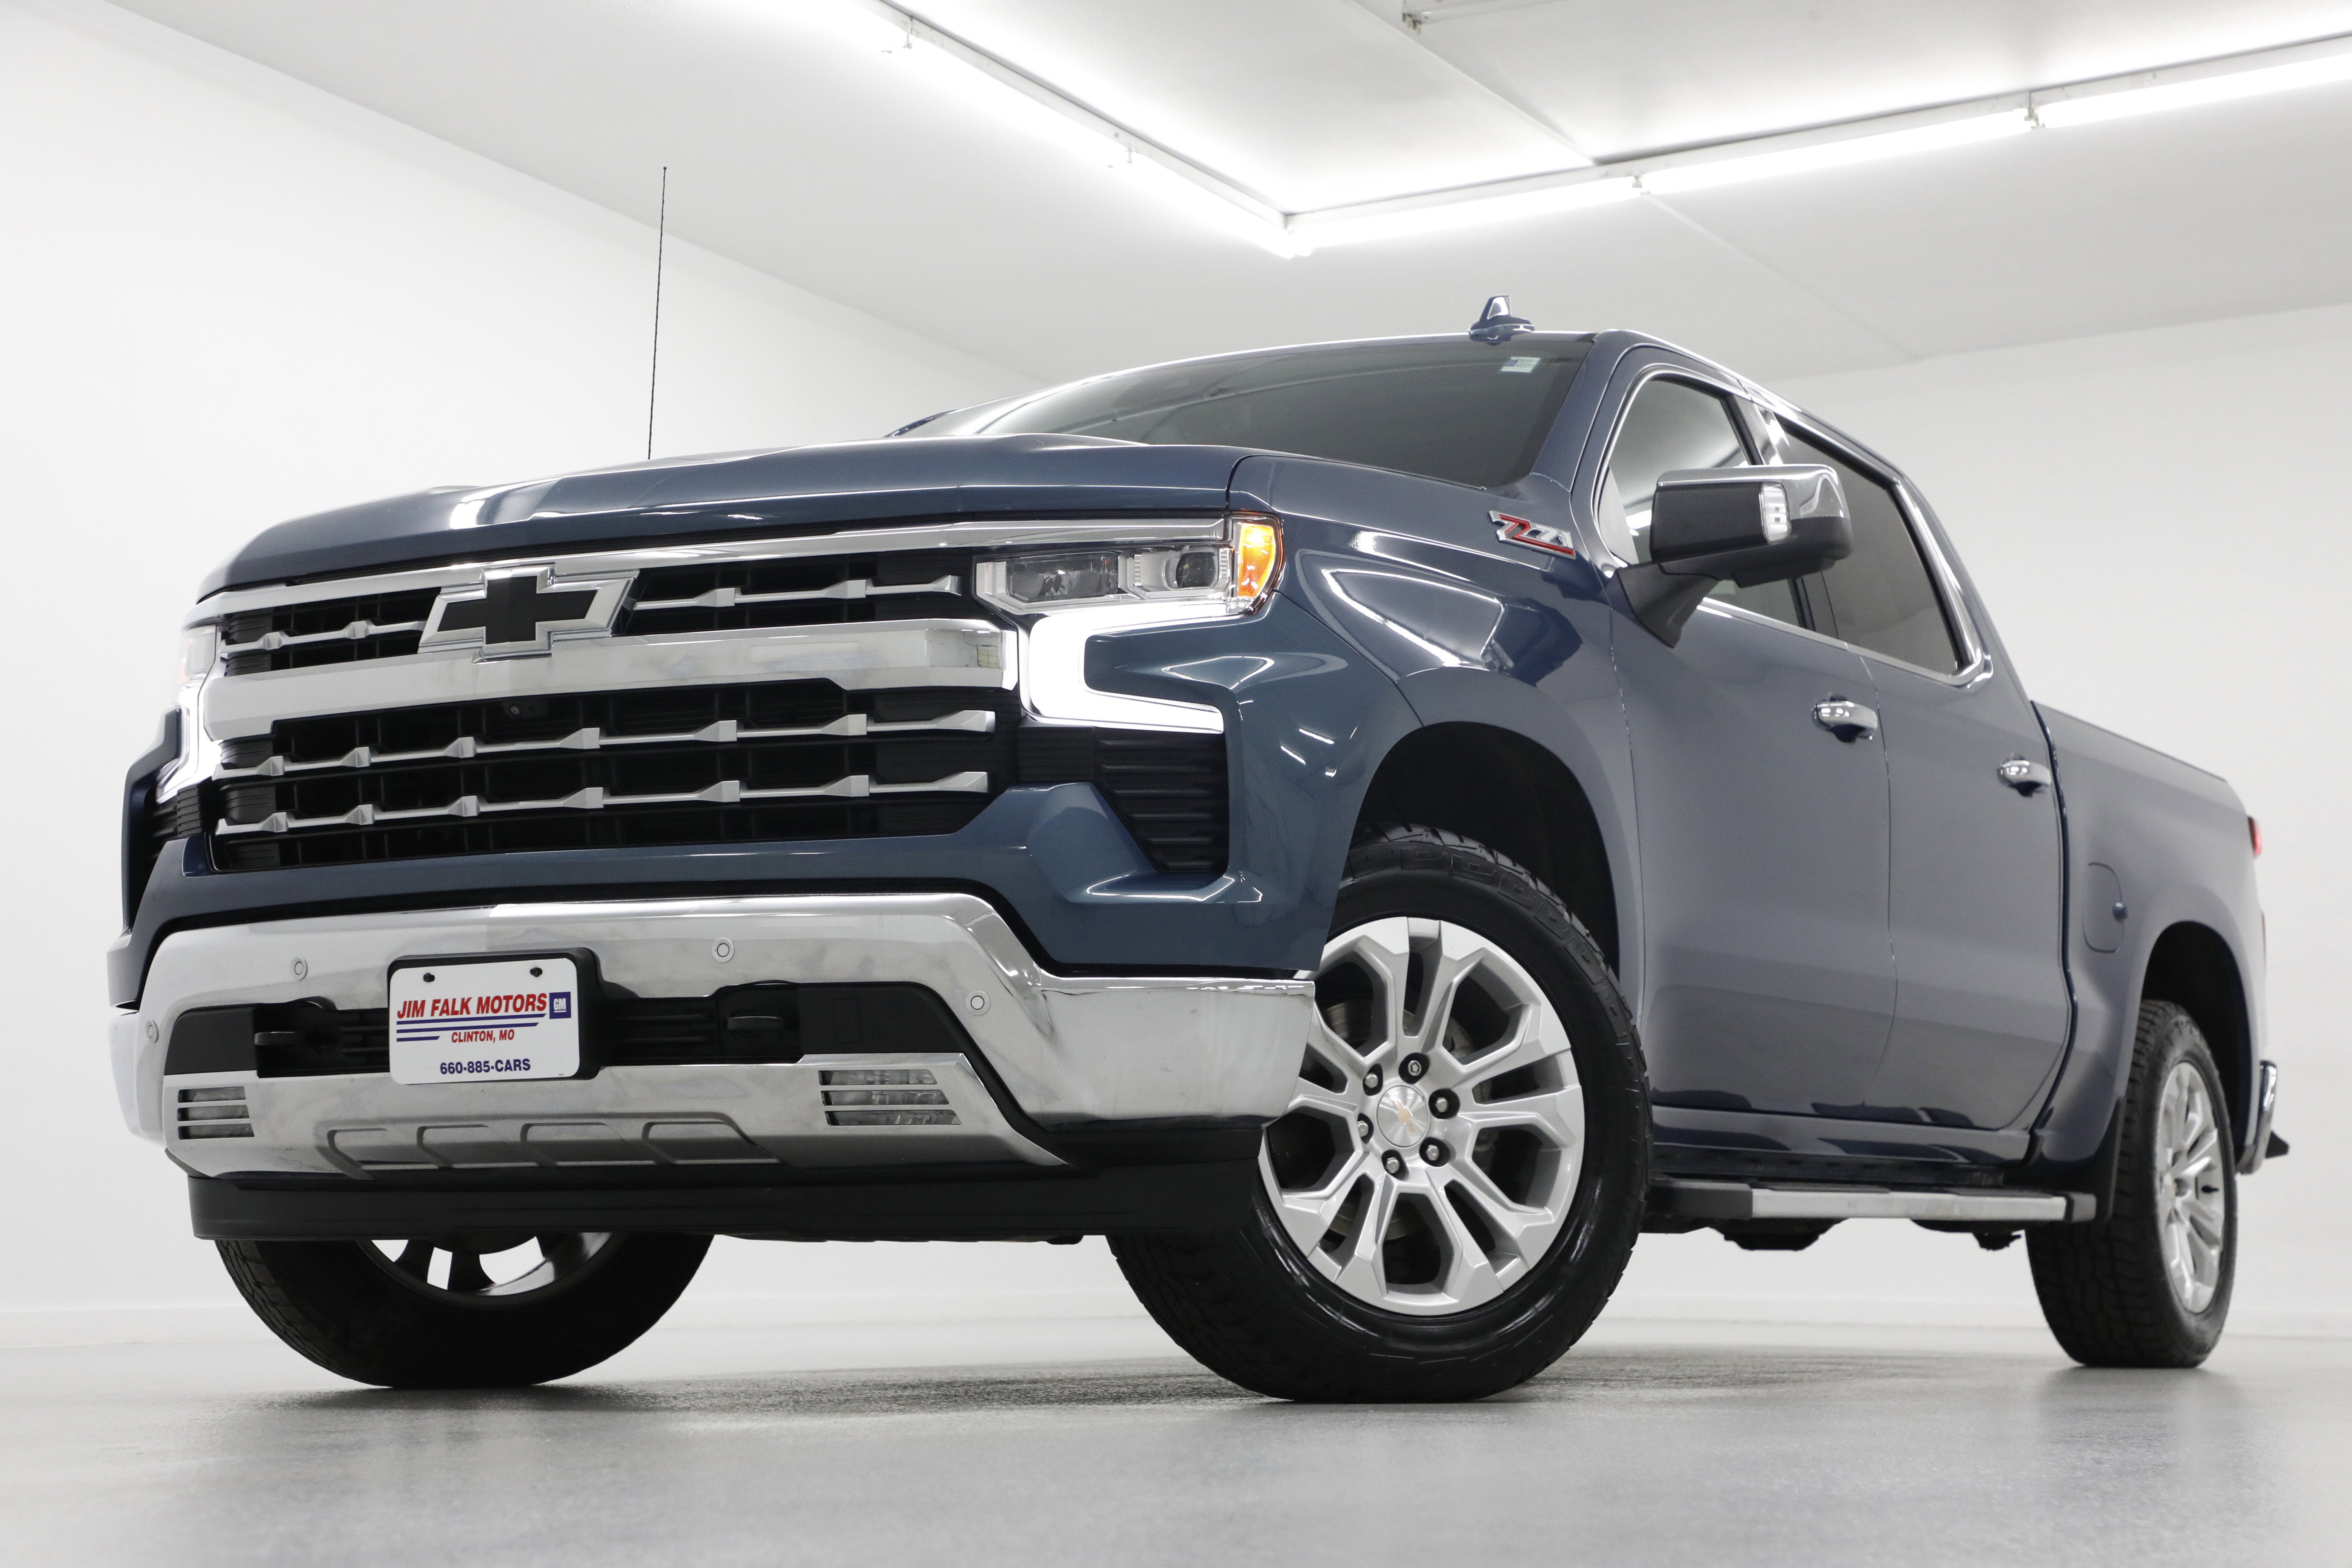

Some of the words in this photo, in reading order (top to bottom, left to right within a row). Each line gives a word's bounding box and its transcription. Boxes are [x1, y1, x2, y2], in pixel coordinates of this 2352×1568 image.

[397, 1000, 426, 1019] JIM
[431, 997, 472, 1017] FALK
[477, 993, 548, 1014] MOTORS
[553, 998, 566, 1010] GM
[452, 1030, 495, 1043] CLINTON,
[499, 1029, 515, 1040] MO
[440, 1058, 530, 1074] 660-885-CARS
